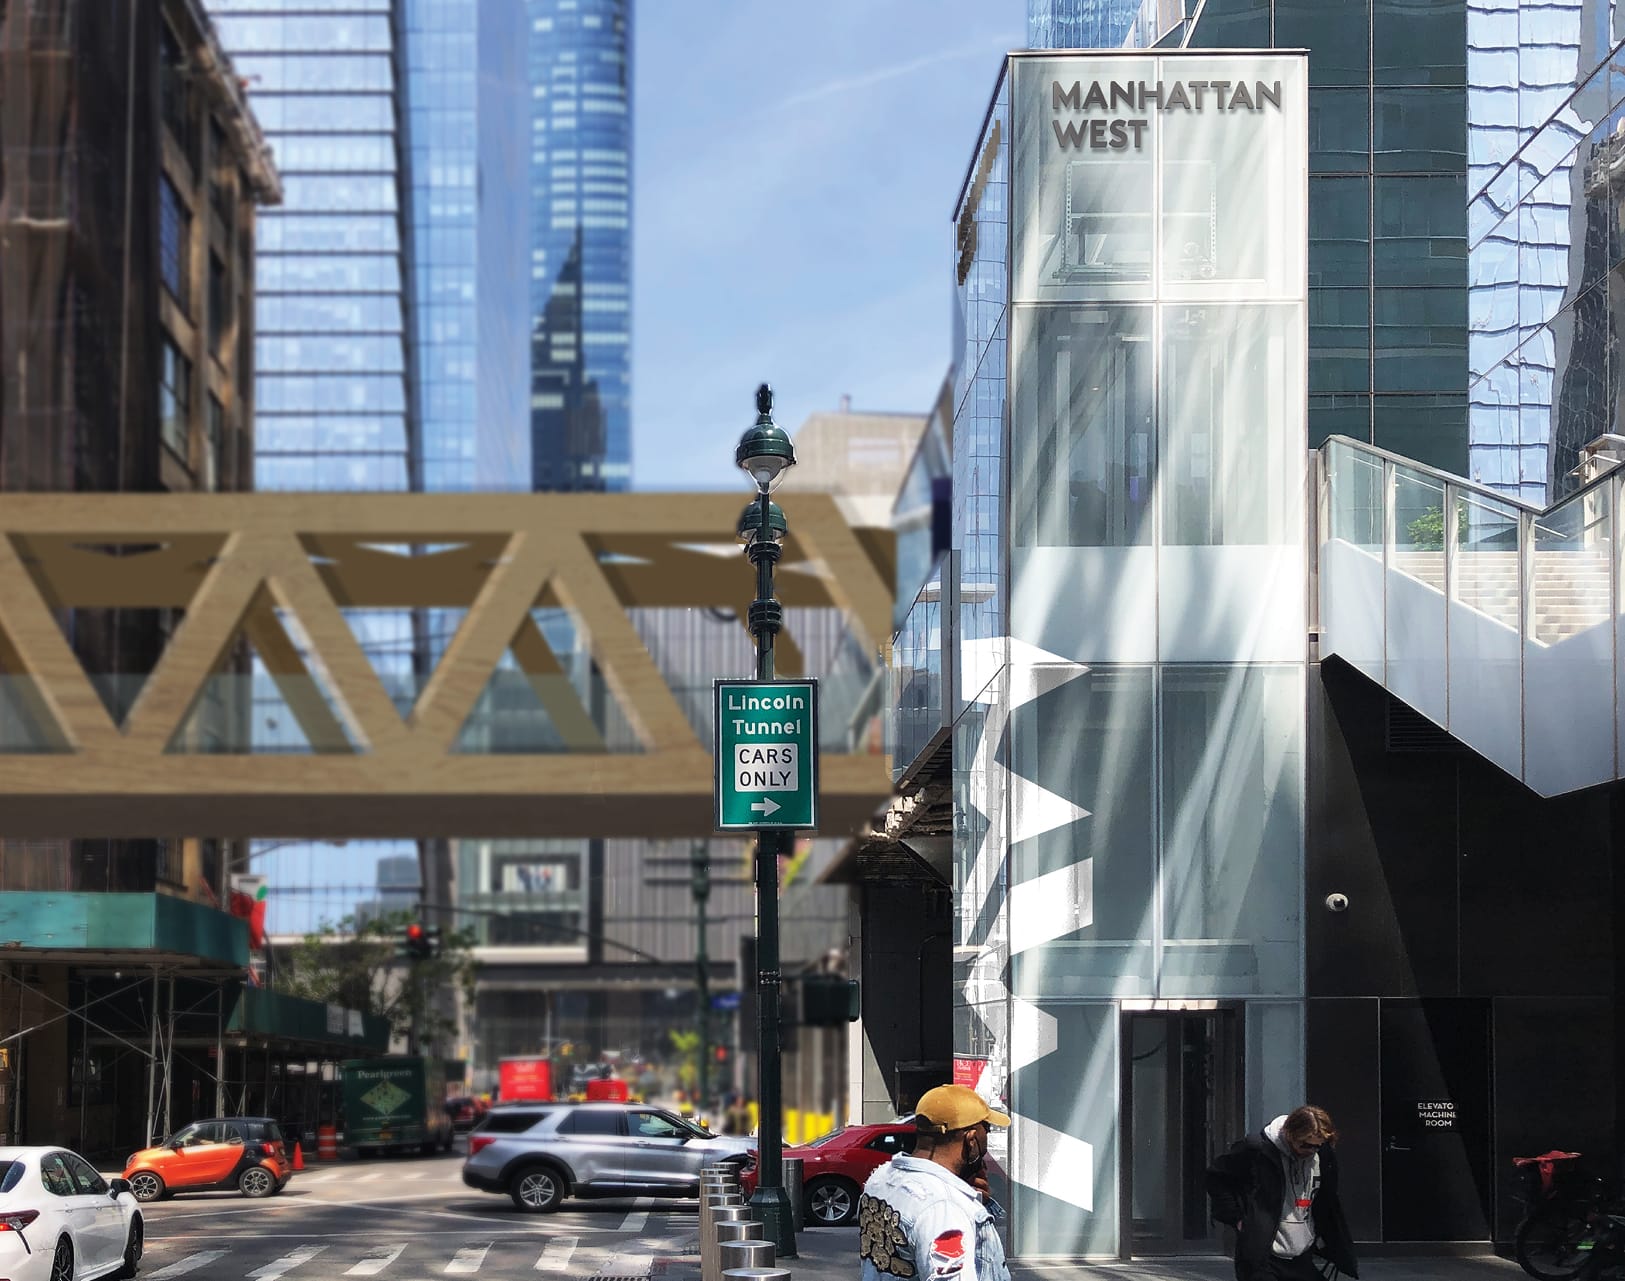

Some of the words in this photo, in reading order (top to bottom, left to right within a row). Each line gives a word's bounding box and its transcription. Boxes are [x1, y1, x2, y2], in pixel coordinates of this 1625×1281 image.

[1052, 80, 1281, 110] MANHATTAN
[1052, 118, 1148, 149] WEST
[728, 694, 804, 711] Lincoln
[732, 719, 801, 735] Tunnel
[739, 748, 793, 764] CARS
[739, 771, 792, 787] ONLY
[1425, 1119, 1452, 1127] ROOM
